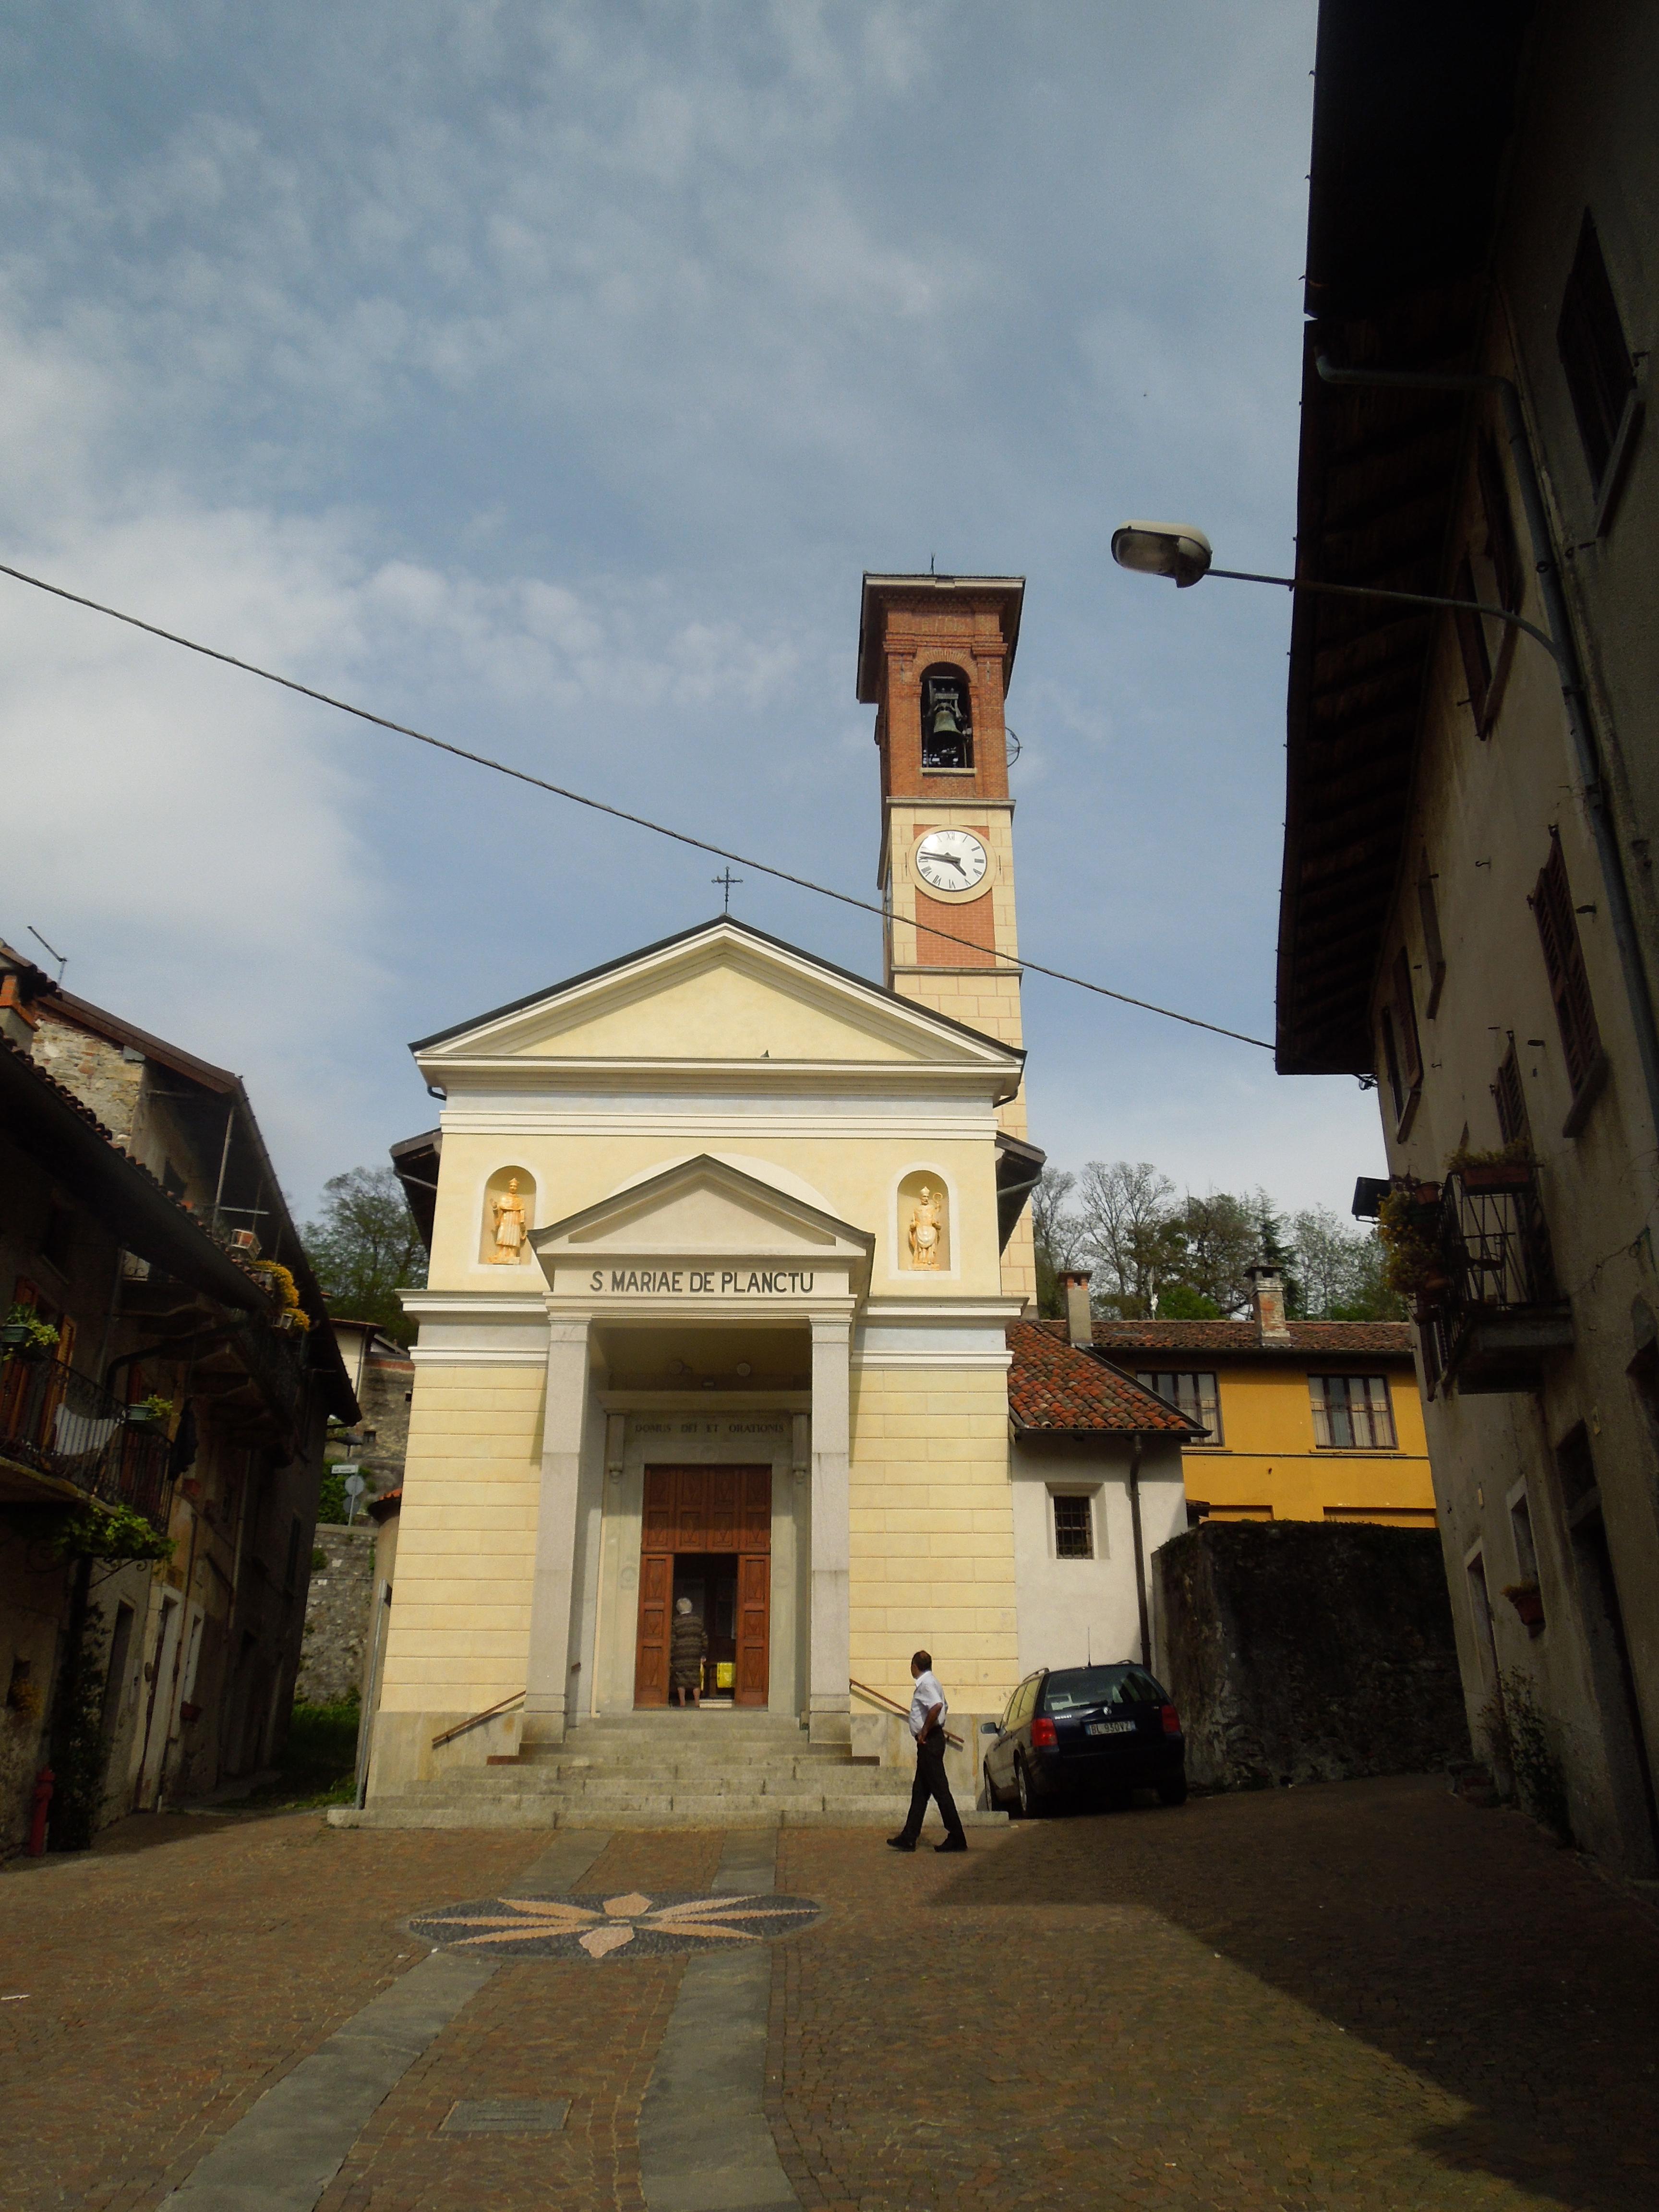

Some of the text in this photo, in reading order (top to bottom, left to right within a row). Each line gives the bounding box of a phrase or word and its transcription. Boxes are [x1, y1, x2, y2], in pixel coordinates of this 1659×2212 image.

[589, 1271, 814, 1293] S. MARIAE DE PLANCTU
[729, 1424, 784, 1433] ORATIONIS
